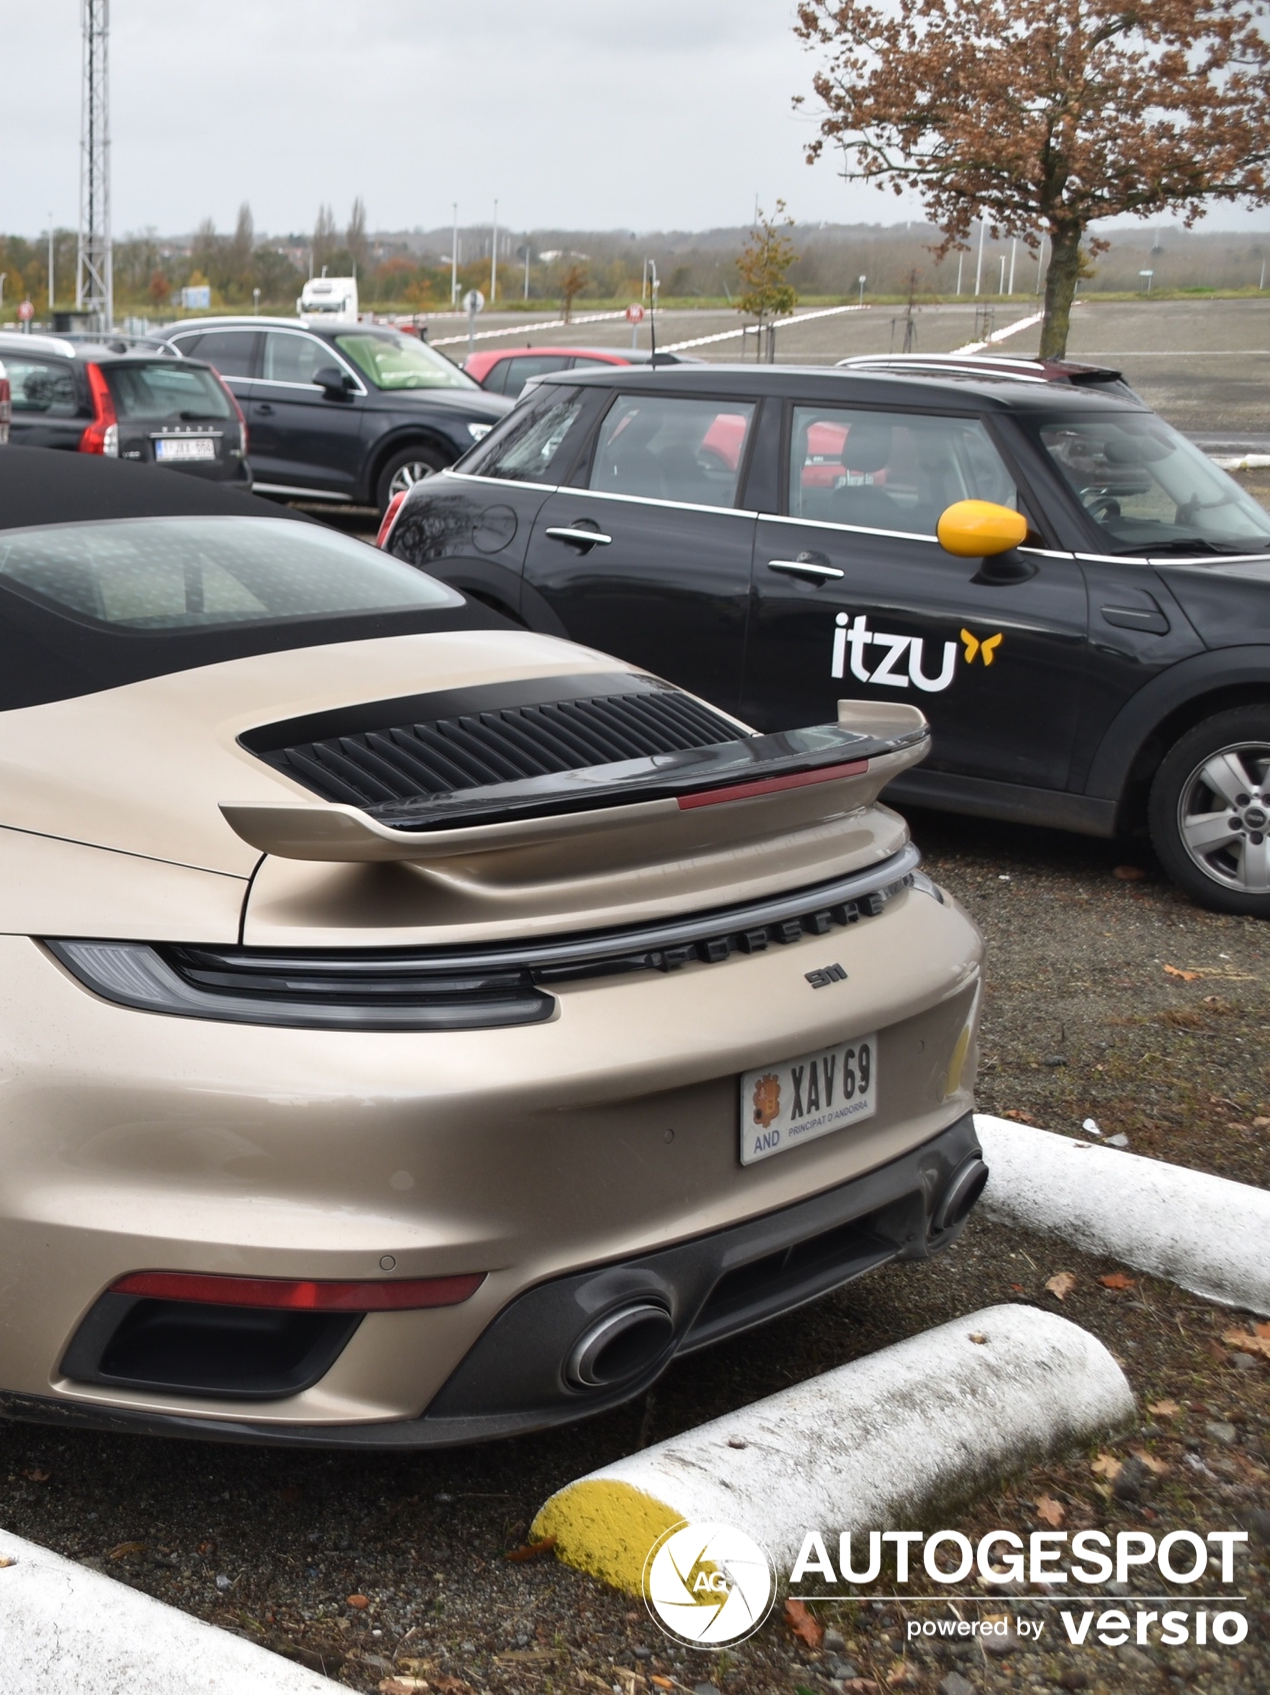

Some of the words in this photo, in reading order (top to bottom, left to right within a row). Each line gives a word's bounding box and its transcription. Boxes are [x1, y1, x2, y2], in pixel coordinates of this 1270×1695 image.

[831, 612, 957, 692] itzu
[661, 893, 885, 973] PORSCHE
[803, 962, 849, 990] 911
[790, 1054, 836, 1121] XAV
[843, 1043, 870, 1100] 69
[753, 1130, 780, 1154] AND
[788, 1114, 826, 1137] PRINCIPAT
[827, 1099, 868, 1122] D'ANDORRA
